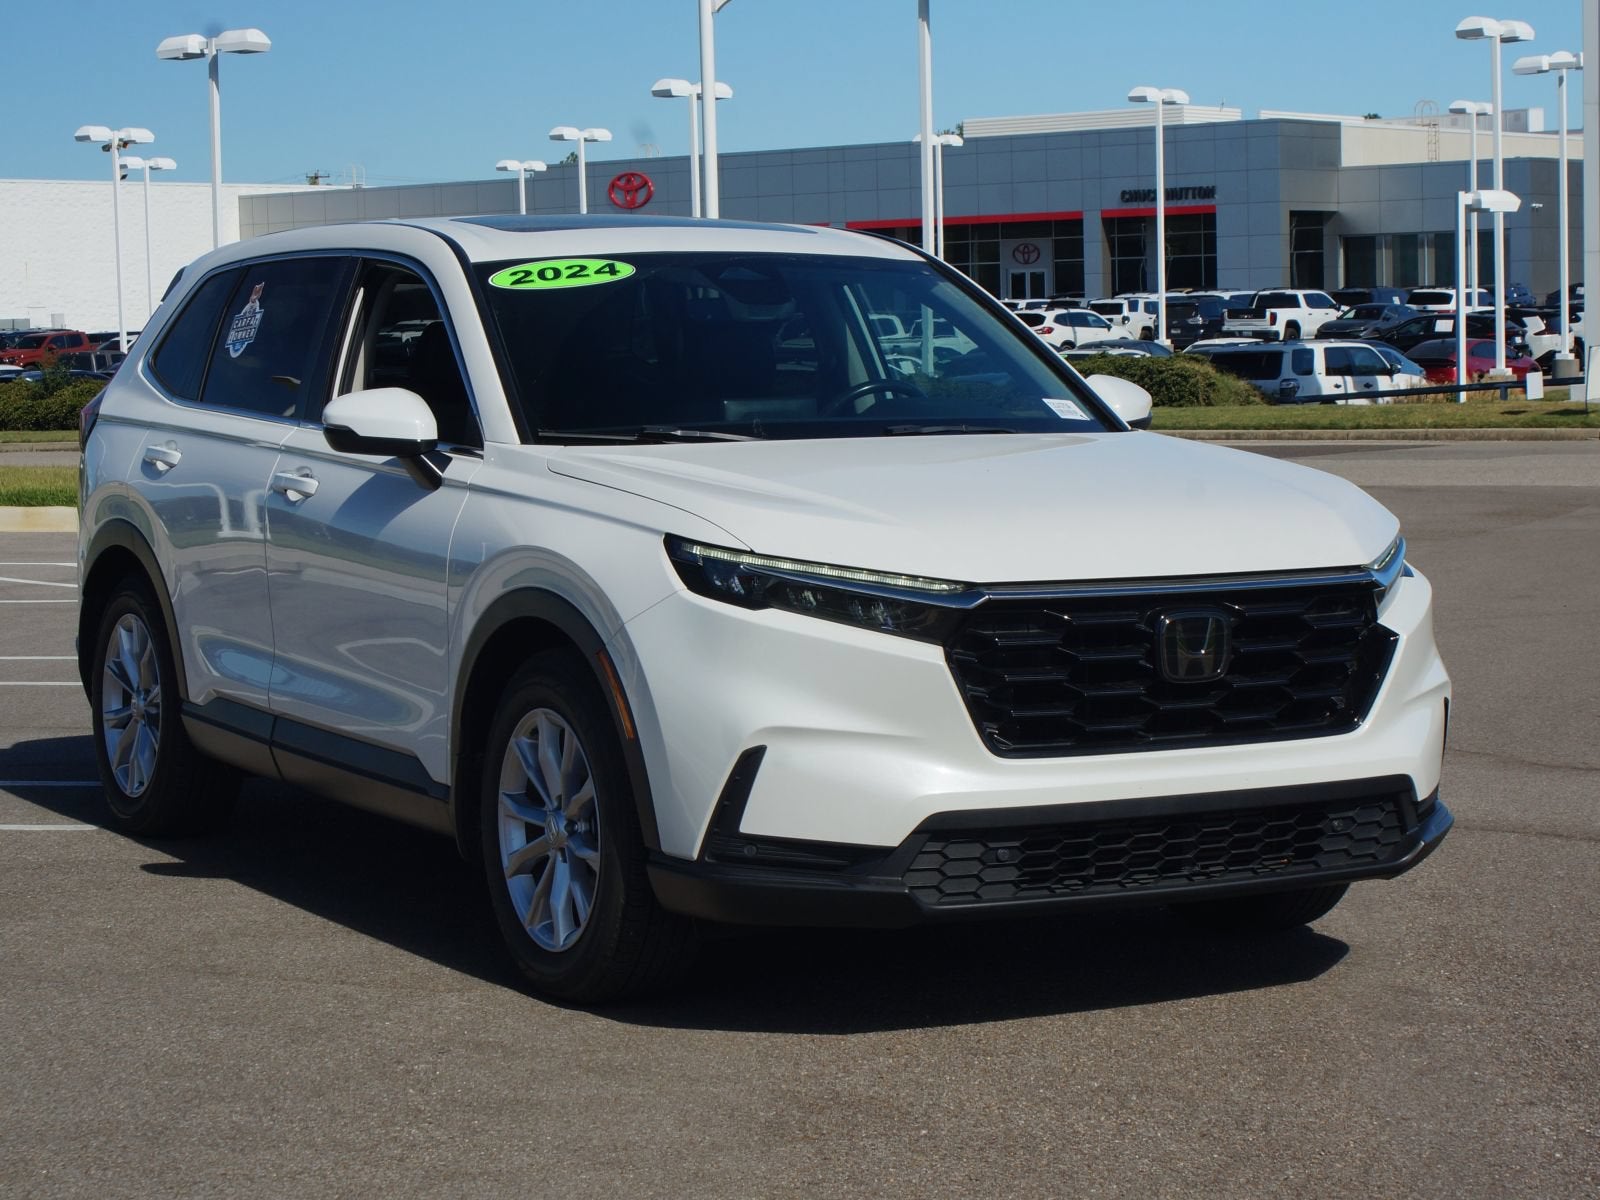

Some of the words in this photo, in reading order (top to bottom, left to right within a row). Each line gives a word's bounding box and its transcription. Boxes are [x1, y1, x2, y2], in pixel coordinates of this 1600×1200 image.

[1120, 189, 1159, 203] CHUC
[1164, 185, 1216, 201] HUTTON
[508, 262, 621, 286] 2024
